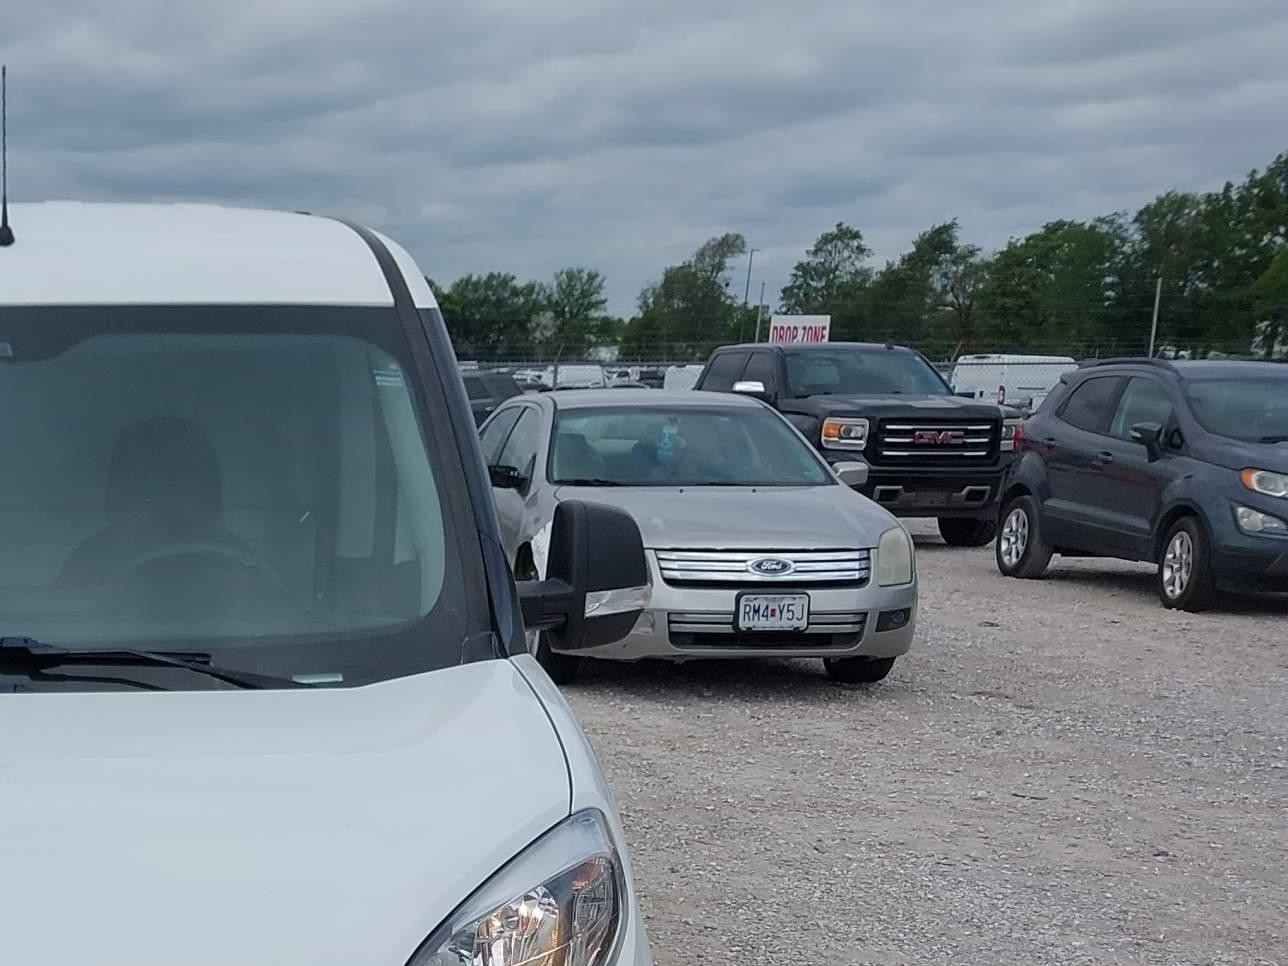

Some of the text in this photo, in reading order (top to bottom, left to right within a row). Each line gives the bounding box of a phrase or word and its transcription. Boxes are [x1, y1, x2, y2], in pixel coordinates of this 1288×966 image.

[772, 326, 827, 342] DROP ZONE
[915, 431, 964, 444] GMC
